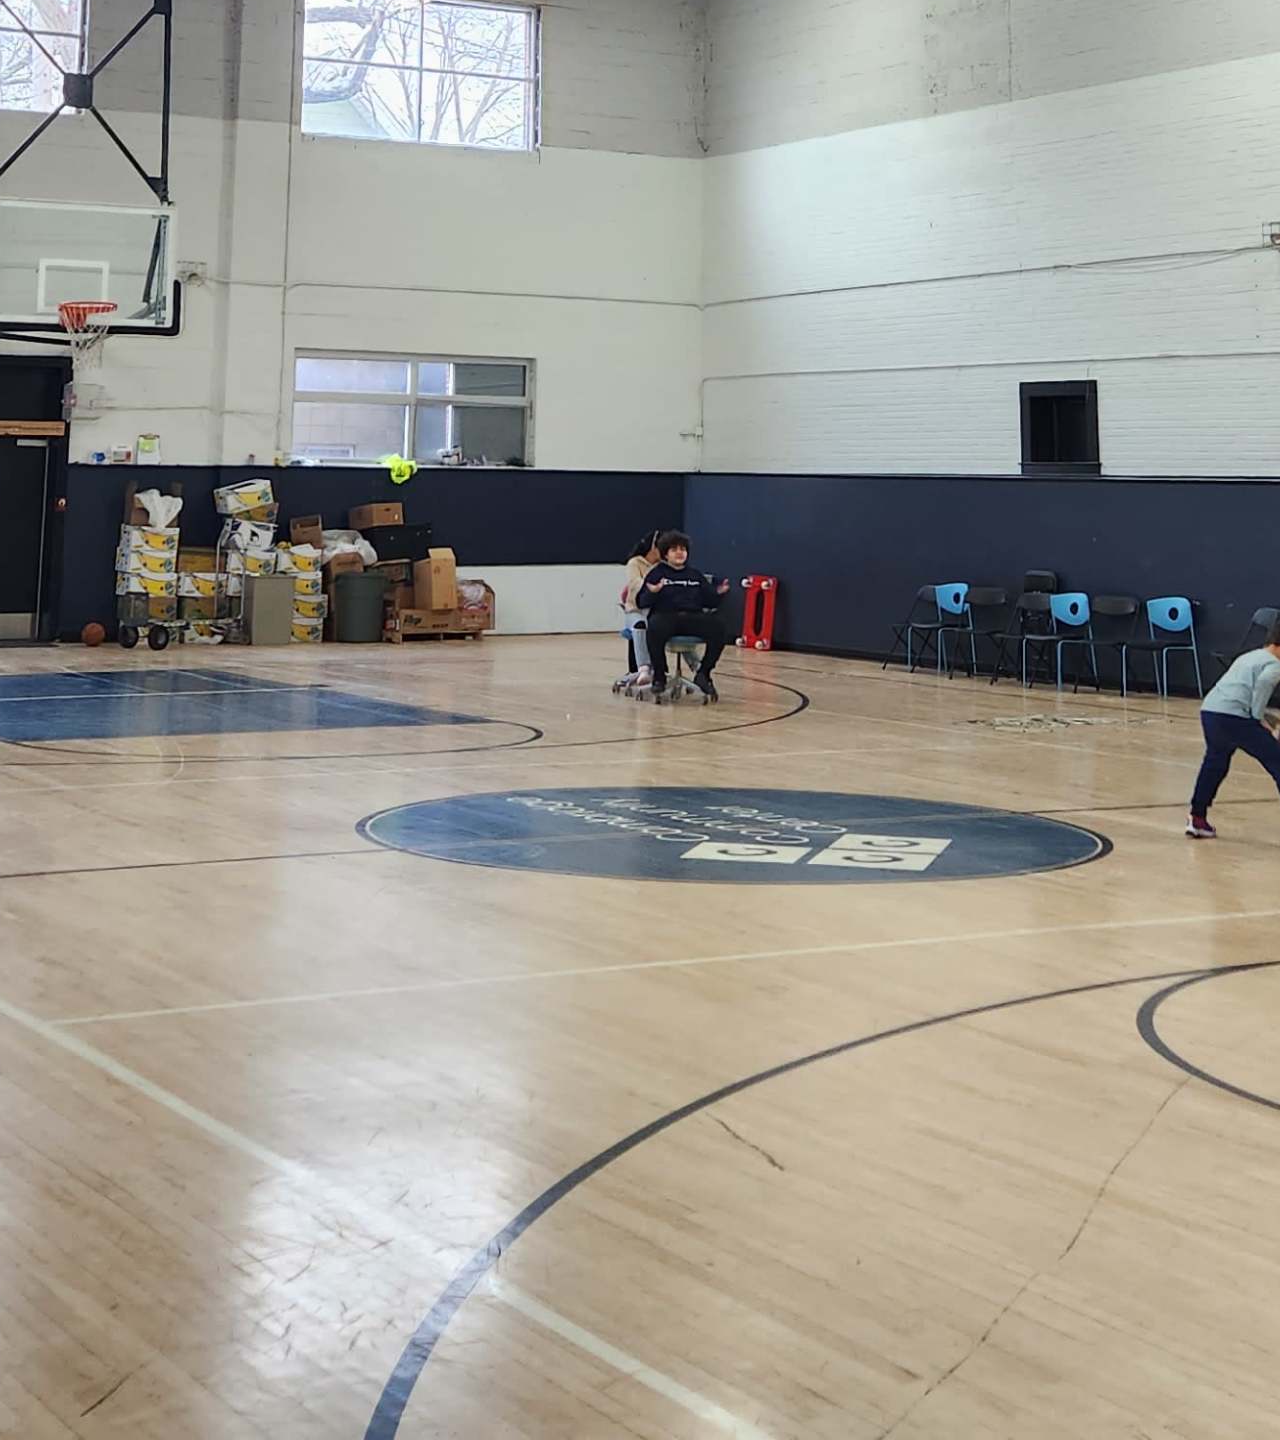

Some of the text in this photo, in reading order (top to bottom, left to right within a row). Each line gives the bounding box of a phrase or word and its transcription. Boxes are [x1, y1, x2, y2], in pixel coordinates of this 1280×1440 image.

[506, 796, 711, 842] Cambridge
[590, 796, 811, 845] Community
[705, 805, 848, 834] Center
